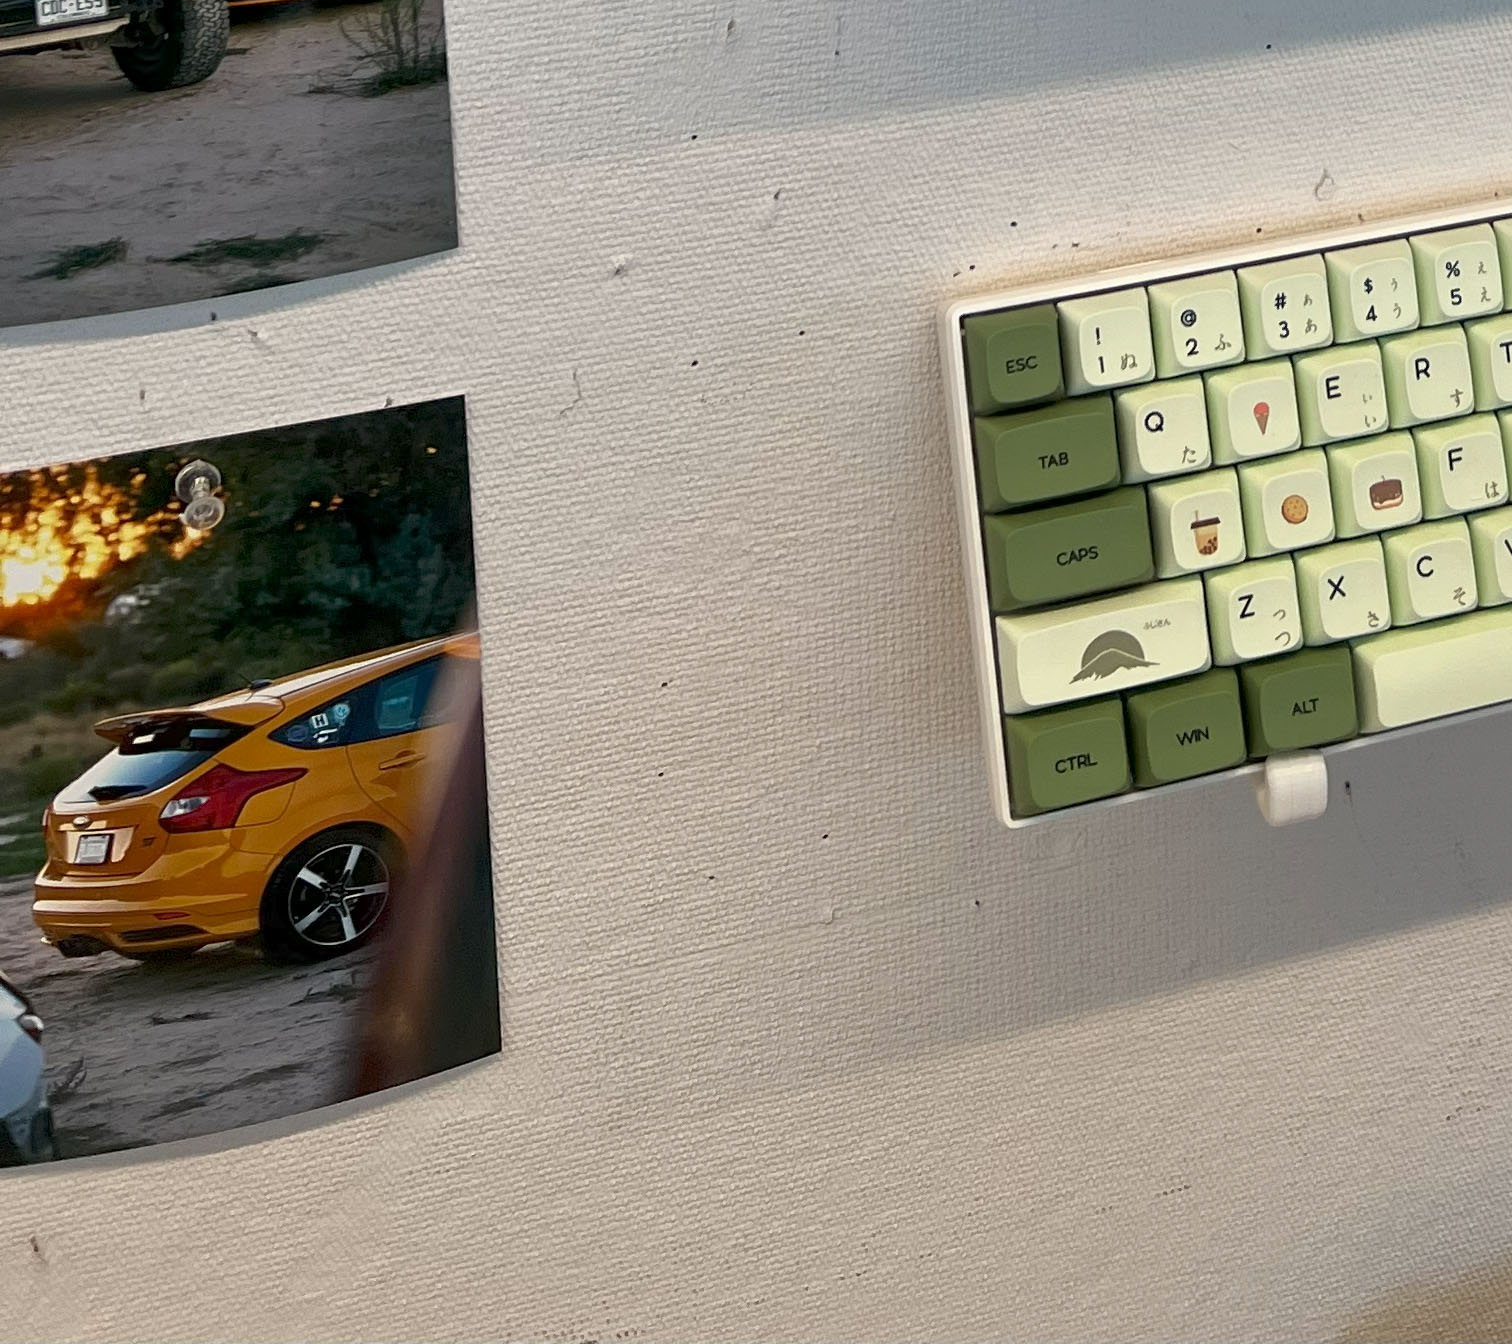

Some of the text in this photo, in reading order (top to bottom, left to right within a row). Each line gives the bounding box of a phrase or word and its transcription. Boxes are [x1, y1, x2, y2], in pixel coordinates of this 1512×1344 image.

[1445, 260, 1460, 279] %
[1364, 278, 1373, 294] $
[1274, 292, 1286, 310] #
[1450, 288, 1462, 306] 5
[1180, 309, 1197, 327] @
[1366, 305, 1378, 321] 4
[1095, 327, 1102, 345] !
[1279, 321, 1290, 338] 3
[1186, 338, 1199, 356] 2
[1006, 356, 1038, 374] ESC
[1097, 356, 1106, 373] 1
[1415, 358, 1430, 380] R
[1325, 376, 1342, 399] E
[1144, 411, 1164, 433] Q
[1038, 452, 1069, 469] TAB
[1448, 447, 1463, 471] F
[1056, 546, 1099, 566] CAPS
[1416, 556, 1434, 577] C
[1327, 576, 1346, 600] X
[1238, 594, 1255, 619] Z
[1292, 698, 1319, 716] ALT
[1176, 726, 1209, 746] WIN
[1055, 753, 1098, 774] CTRL
